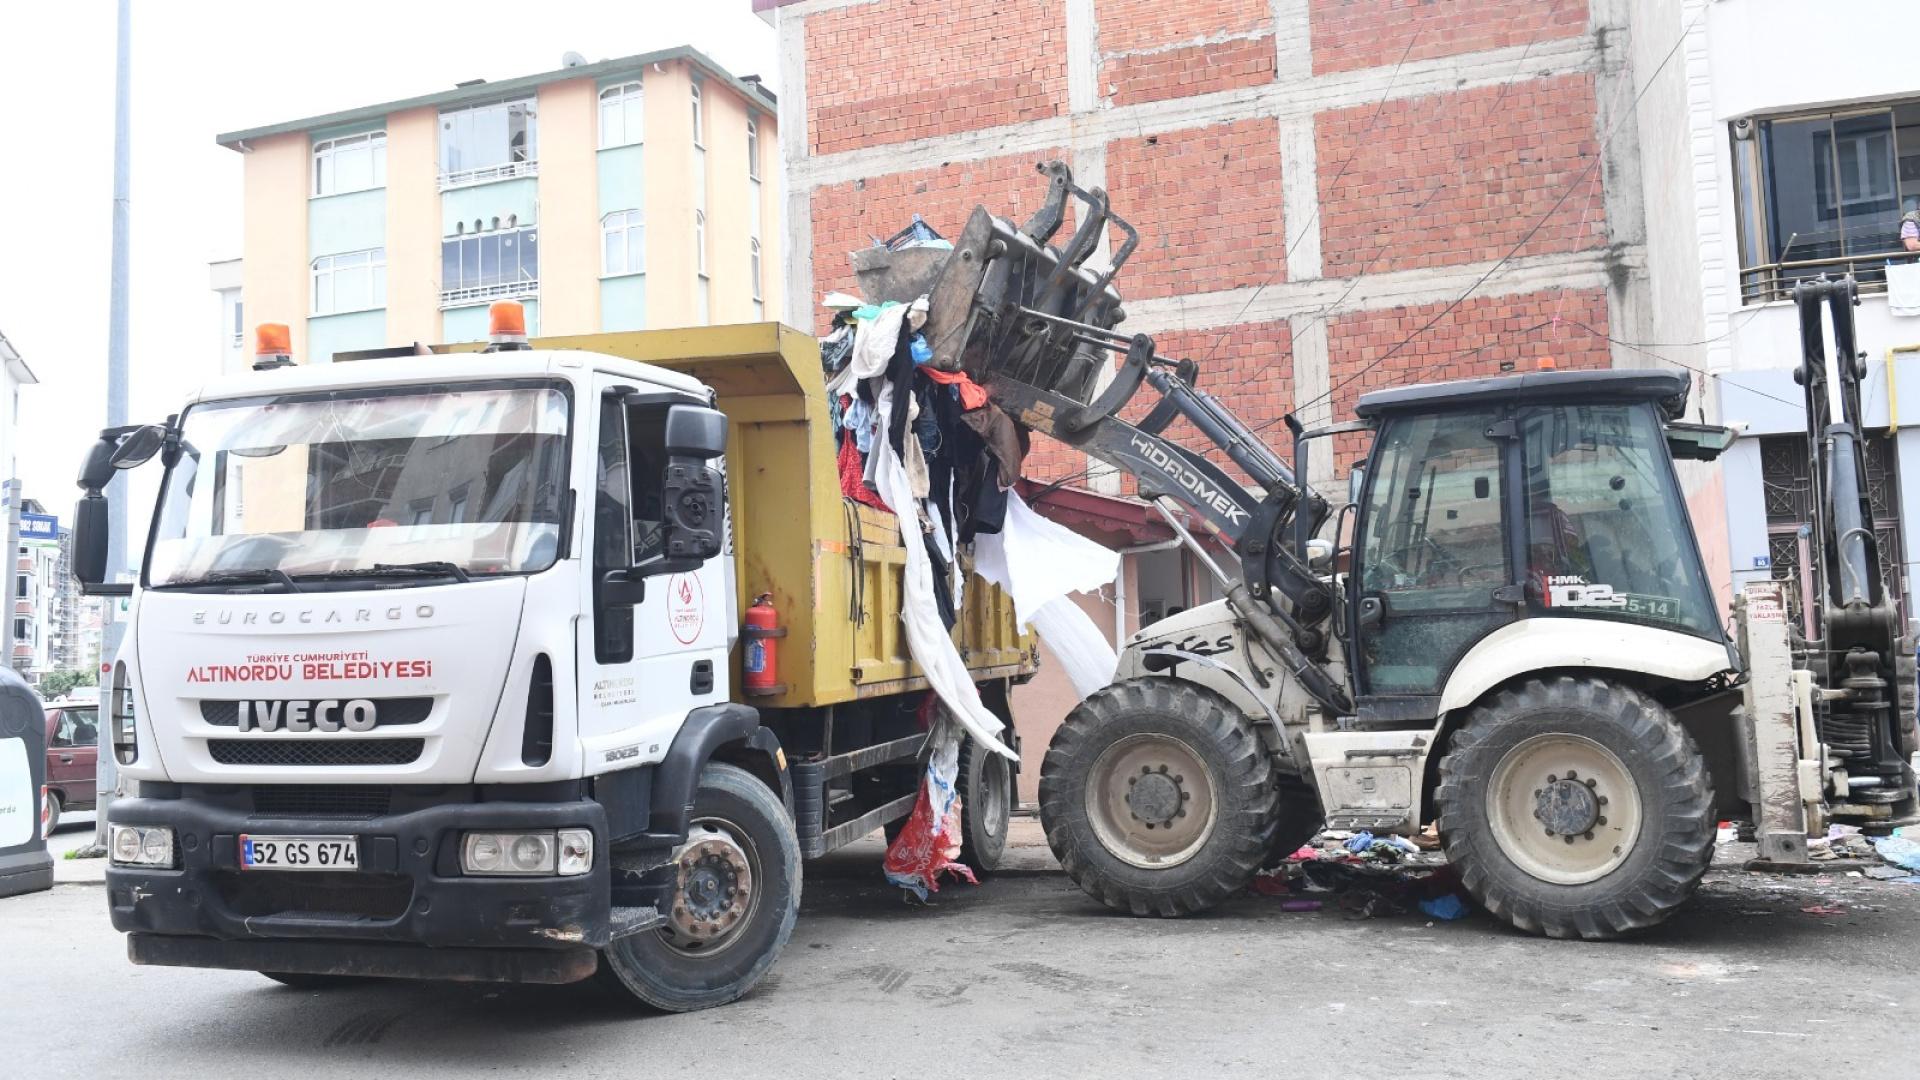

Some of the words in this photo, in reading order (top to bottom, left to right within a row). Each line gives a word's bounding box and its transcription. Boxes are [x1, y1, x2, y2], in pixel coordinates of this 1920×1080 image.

[32, 520, 52, 533] SOKAK
[1548, 575, 1585, 584] HMK
[193, 604, 434, 624] EUROCARGO
[246, 653, 290, 663] TÜRKİYE
[293, 650, 368, 662] CUMHURİYETİ
[187, 665, 292, 682] ALTINORDU
[303, 660, 432, 680] BELEDİYESİ
[238, 699, 377, 733] IVECO
[253, 843, 278, 864] 52
[285, 843, 310, 864] GS
[317, 843, 355, 865] 674
